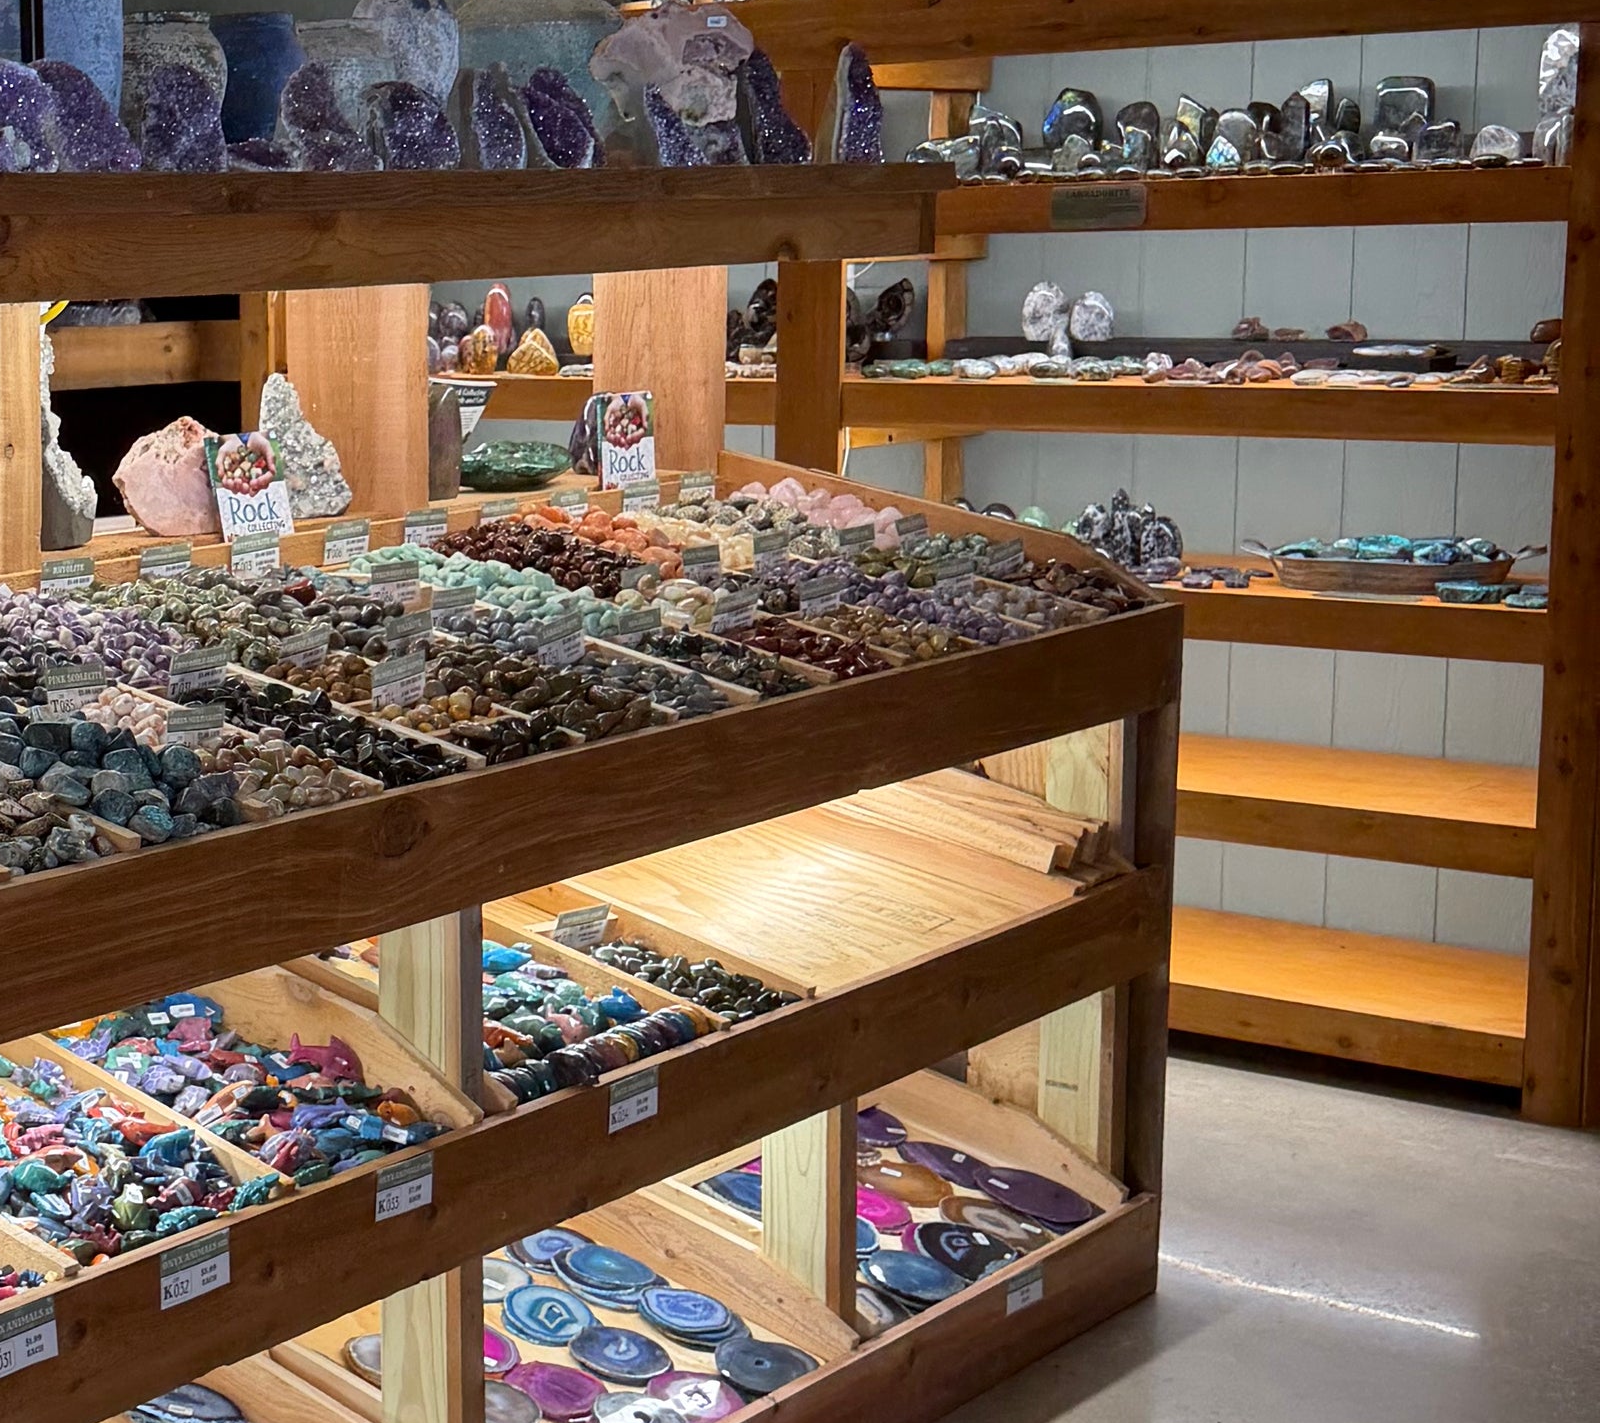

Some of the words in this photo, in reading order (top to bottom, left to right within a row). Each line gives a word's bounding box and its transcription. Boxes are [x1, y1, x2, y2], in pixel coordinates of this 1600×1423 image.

[609, 447, 646, 474] Rock
[228, 492, 280, 525] Rock
[248, 520, 285, 532] COLLECTING
[6, 1309, 44, 1331] ANIMALS
